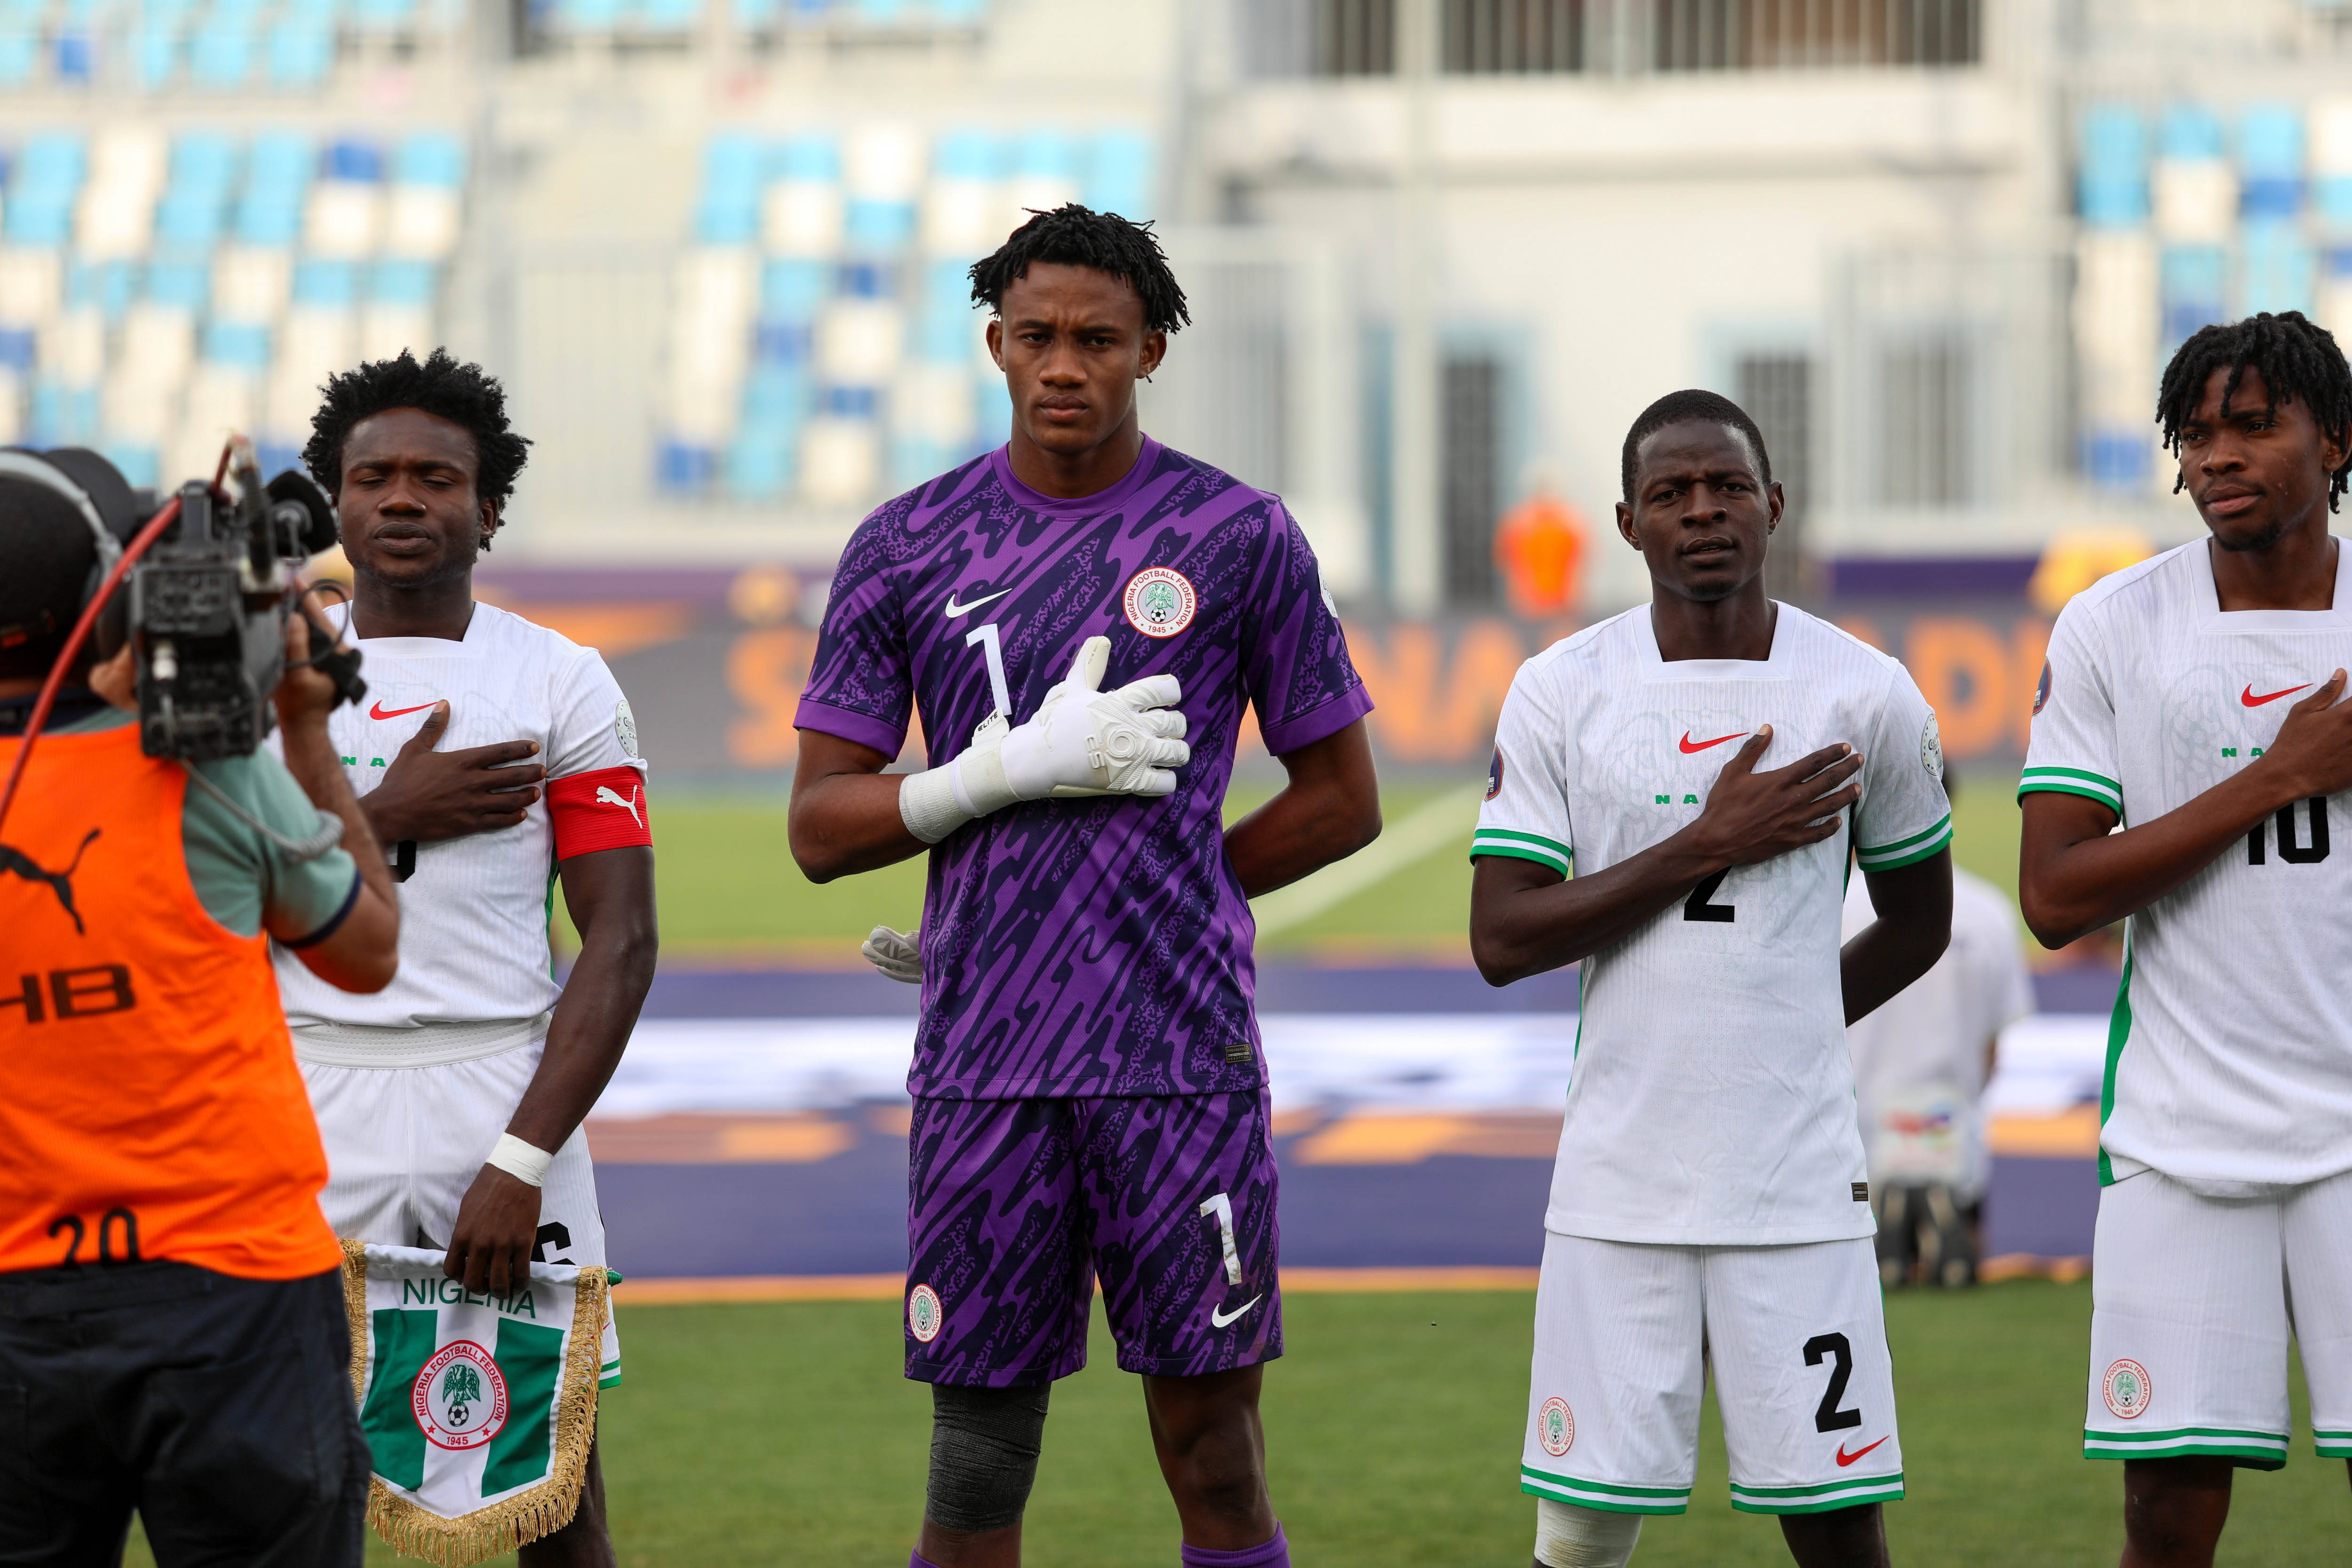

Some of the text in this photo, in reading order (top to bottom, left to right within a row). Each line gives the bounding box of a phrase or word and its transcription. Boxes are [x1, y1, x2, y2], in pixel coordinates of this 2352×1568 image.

[1127, 570, 1192, 626] NIGERIA FOOTBALL FEDERATION
[965, 623, 1012, 716] 1
[978, 711, 998, 731] ELITE
[48, 1207, 140, 1267] 20
[1199, 1192, 1242, 1286] 1
[913, 1287, 929, 1301] FOOTBALL
[929, 1293, 940, 1333] FEDERATION
[416, 1345, 505, 1422] NIGERIA FOOTBALL FEDERATION
[1803, 1332, 1861, 1433] 2
[2105, 1362, 2148, 1407] NIGERIA FOOTBALL FEDERATION
[446, 1436, 469, 1445] 1945
[1543, 1400, 1562, 1414] FOOTBALL
[1562, 1406, 1572, 1446] FEDERATION
